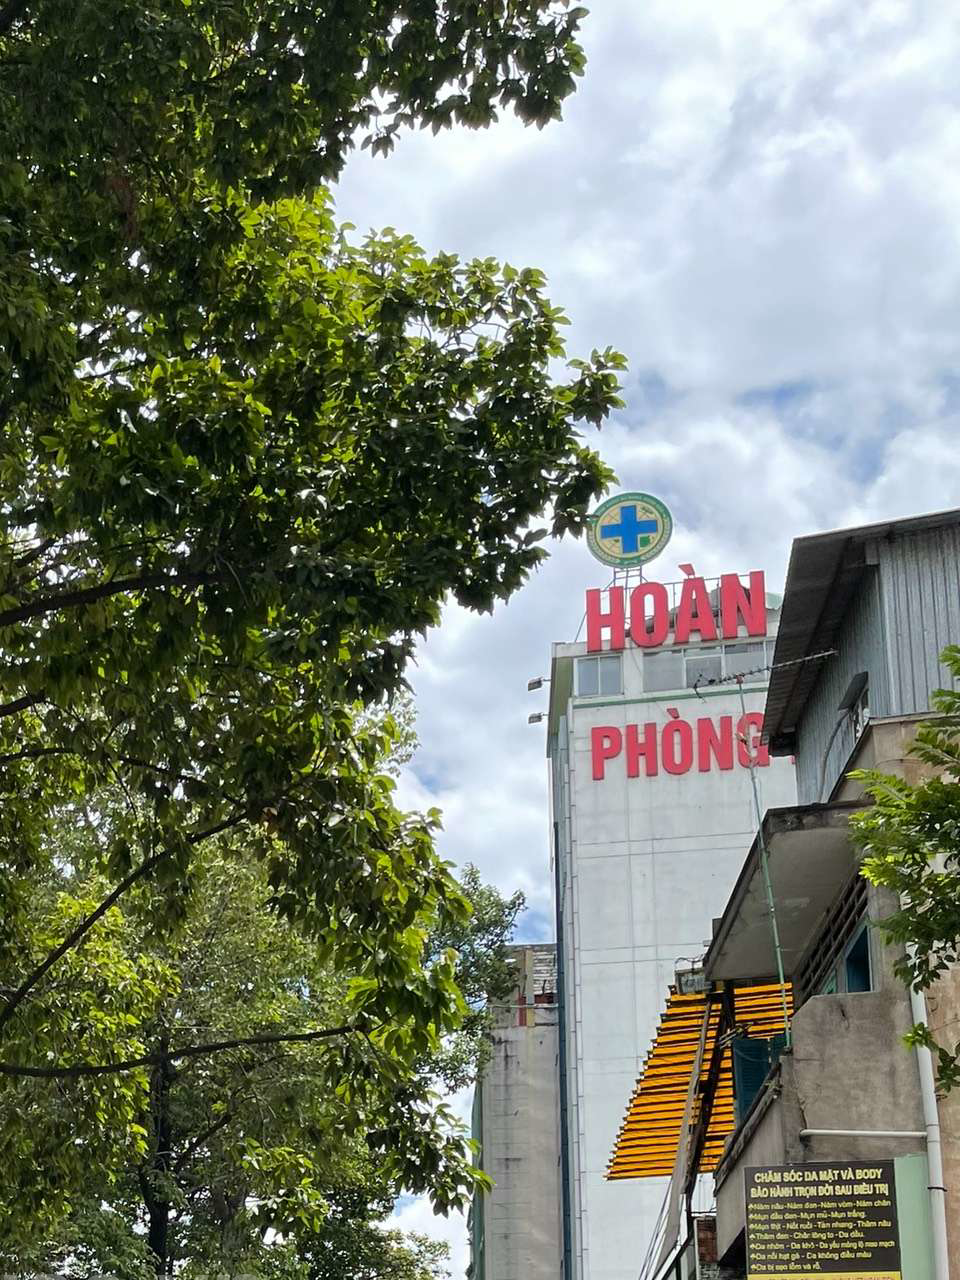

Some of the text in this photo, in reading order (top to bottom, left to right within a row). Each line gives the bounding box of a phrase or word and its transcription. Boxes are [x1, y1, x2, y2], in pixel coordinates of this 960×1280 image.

[586, 564, 767, 652] HOÀN
[591, 708, 770, 781] PHÒNG
[783, 1169, 802, 1182] SÓC
[805, 1172, 818, 1181] DA
[840, 1168, 854, 1180] VÀ
[856, 1169, 883, 1179] BODY
[835, 1185, 852, 1195] SAU
[875, 1183, 888, 1196] TRỊ
